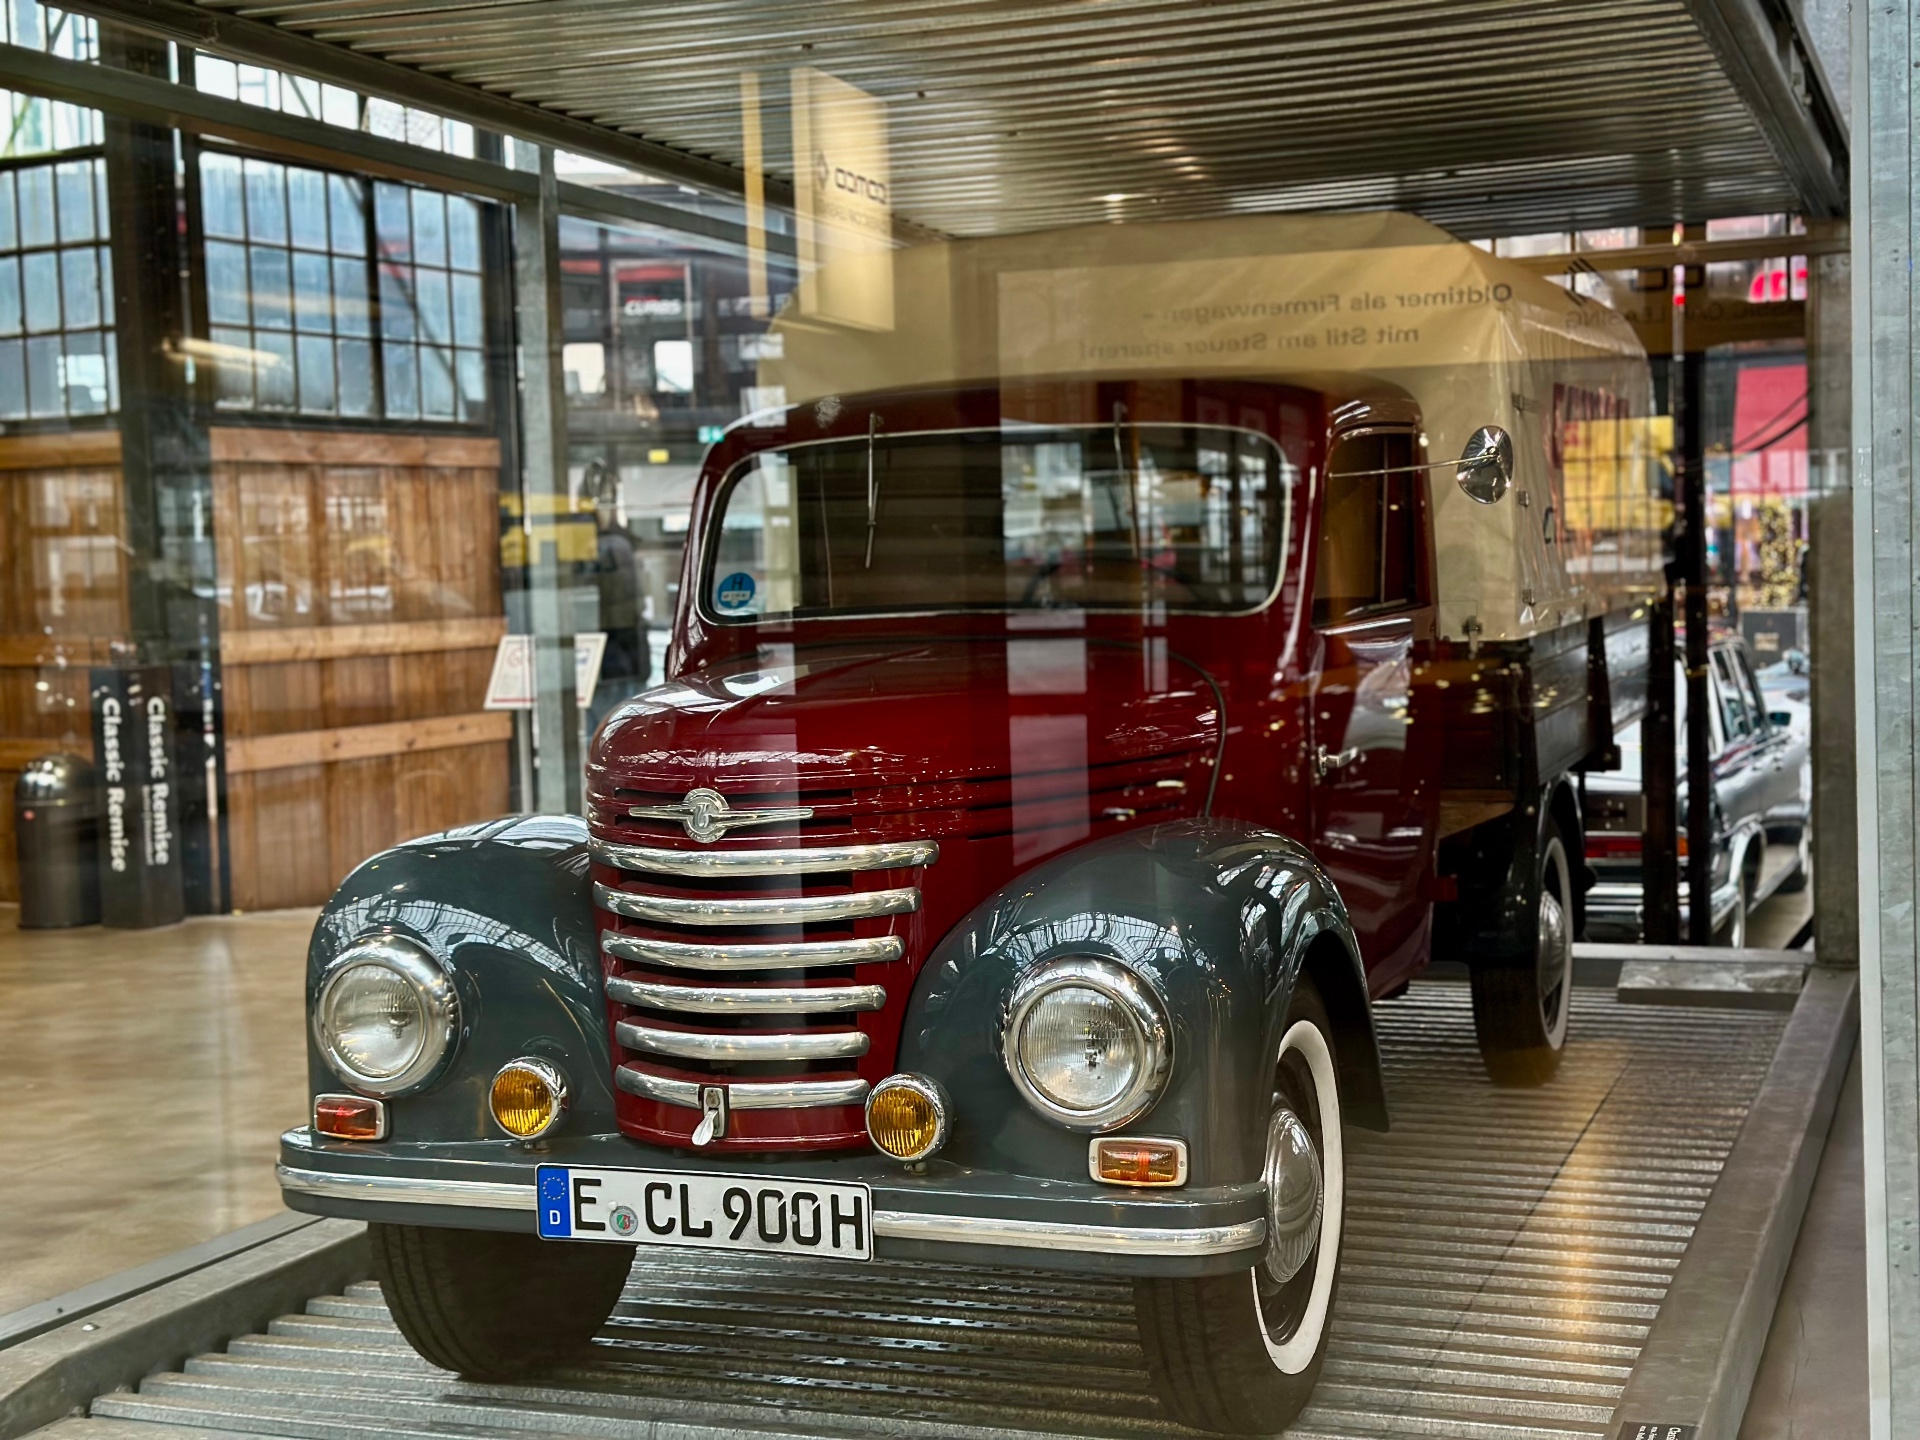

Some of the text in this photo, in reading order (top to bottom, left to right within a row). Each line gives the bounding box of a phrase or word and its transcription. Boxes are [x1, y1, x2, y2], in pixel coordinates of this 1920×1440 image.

[732, 577, 743, 590] H
[147, 696, 169, 779] Classic
[102, 697, 129, 872] Classic Remise
[152, 782, 172, 865] Remise
[549, 1209, 561, 1225] D
[573, 1178, 606, 1232] E
[644, 1182, 713, 1239] CL
